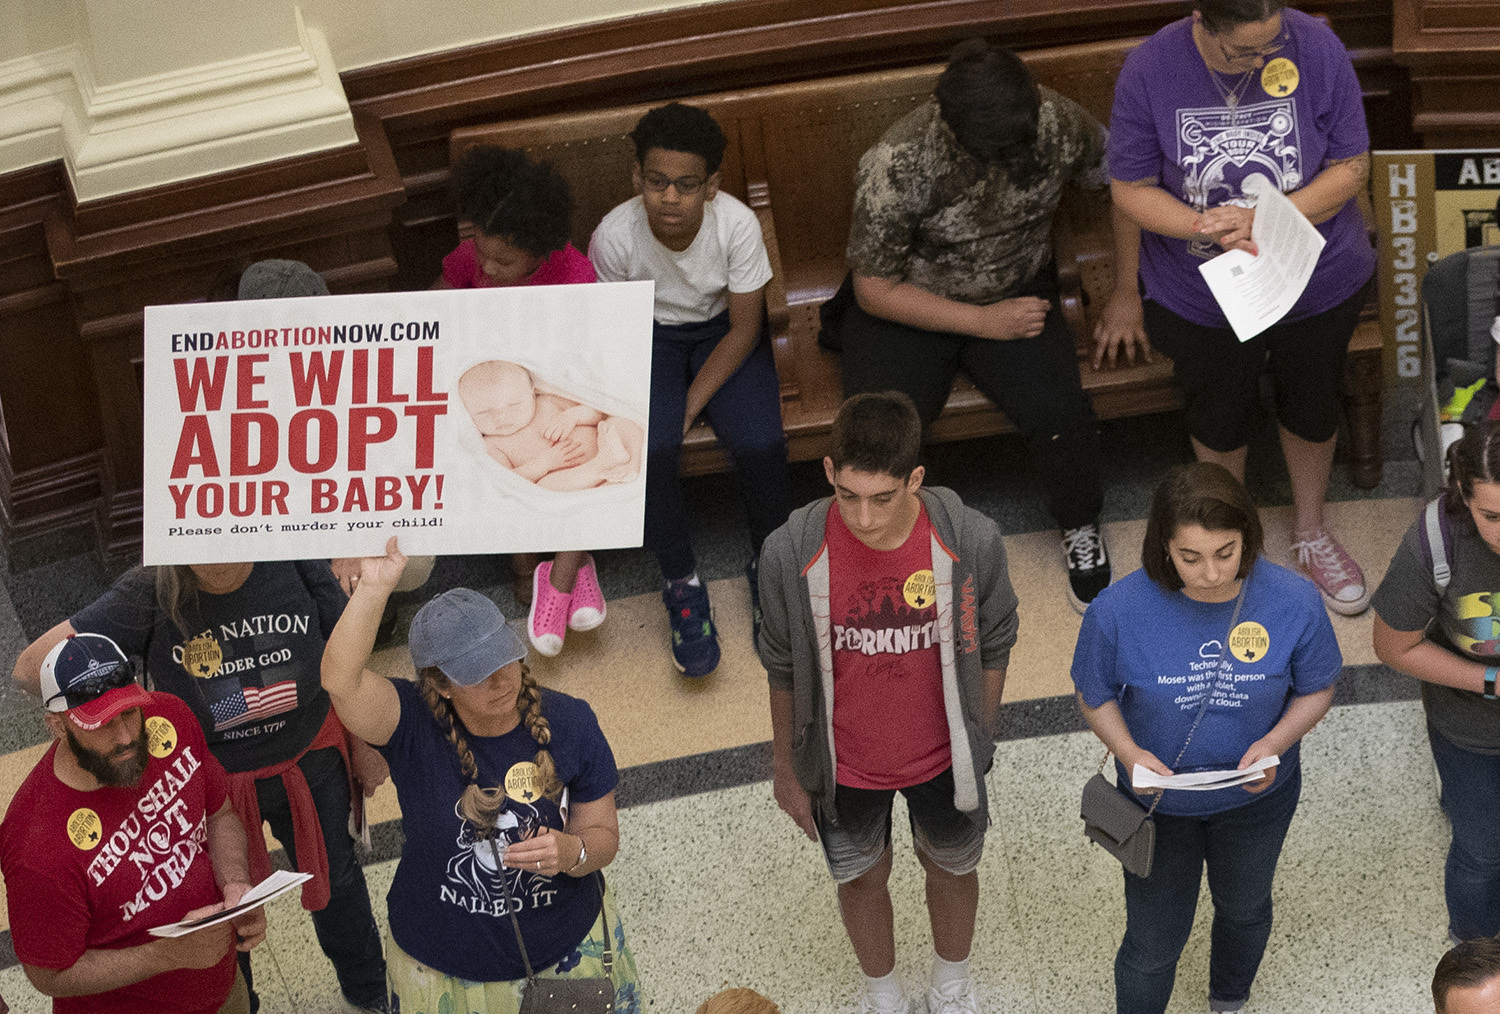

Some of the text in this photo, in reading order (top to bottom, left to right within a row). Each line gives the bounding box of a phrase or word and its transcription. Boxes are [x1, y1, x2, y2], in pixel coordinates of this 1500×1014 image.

[1388, 163, 1421, 378] HB3326
[171, 321, 440, 353] ENDABORTIONNOW.COM
[173, 346, 449, 413] WE WILL
[169, 404, 449, 480] ADOPT
[168, 474, 445, 520] YOUR BABY!
[168, 517, 444, 537] Please don't murder your child!
[220, 614, 310, 641] NATION
[1232, 637, 1267, 649] ABORTION
[259, 648, 292, 666] GOD
[1158, 675, 1187, 685] Moses
[1188, 674, 1205, 683] was
[1235, 673, 1266, 683] person
[1187, 682, 1205, 693] with
[223, 723, 261, 740] SINCE
[73, 813, 97, 847] ABORTION
[87, 813, 141, 887] THOU
[440, 884, 557, 917] NAILED IT
